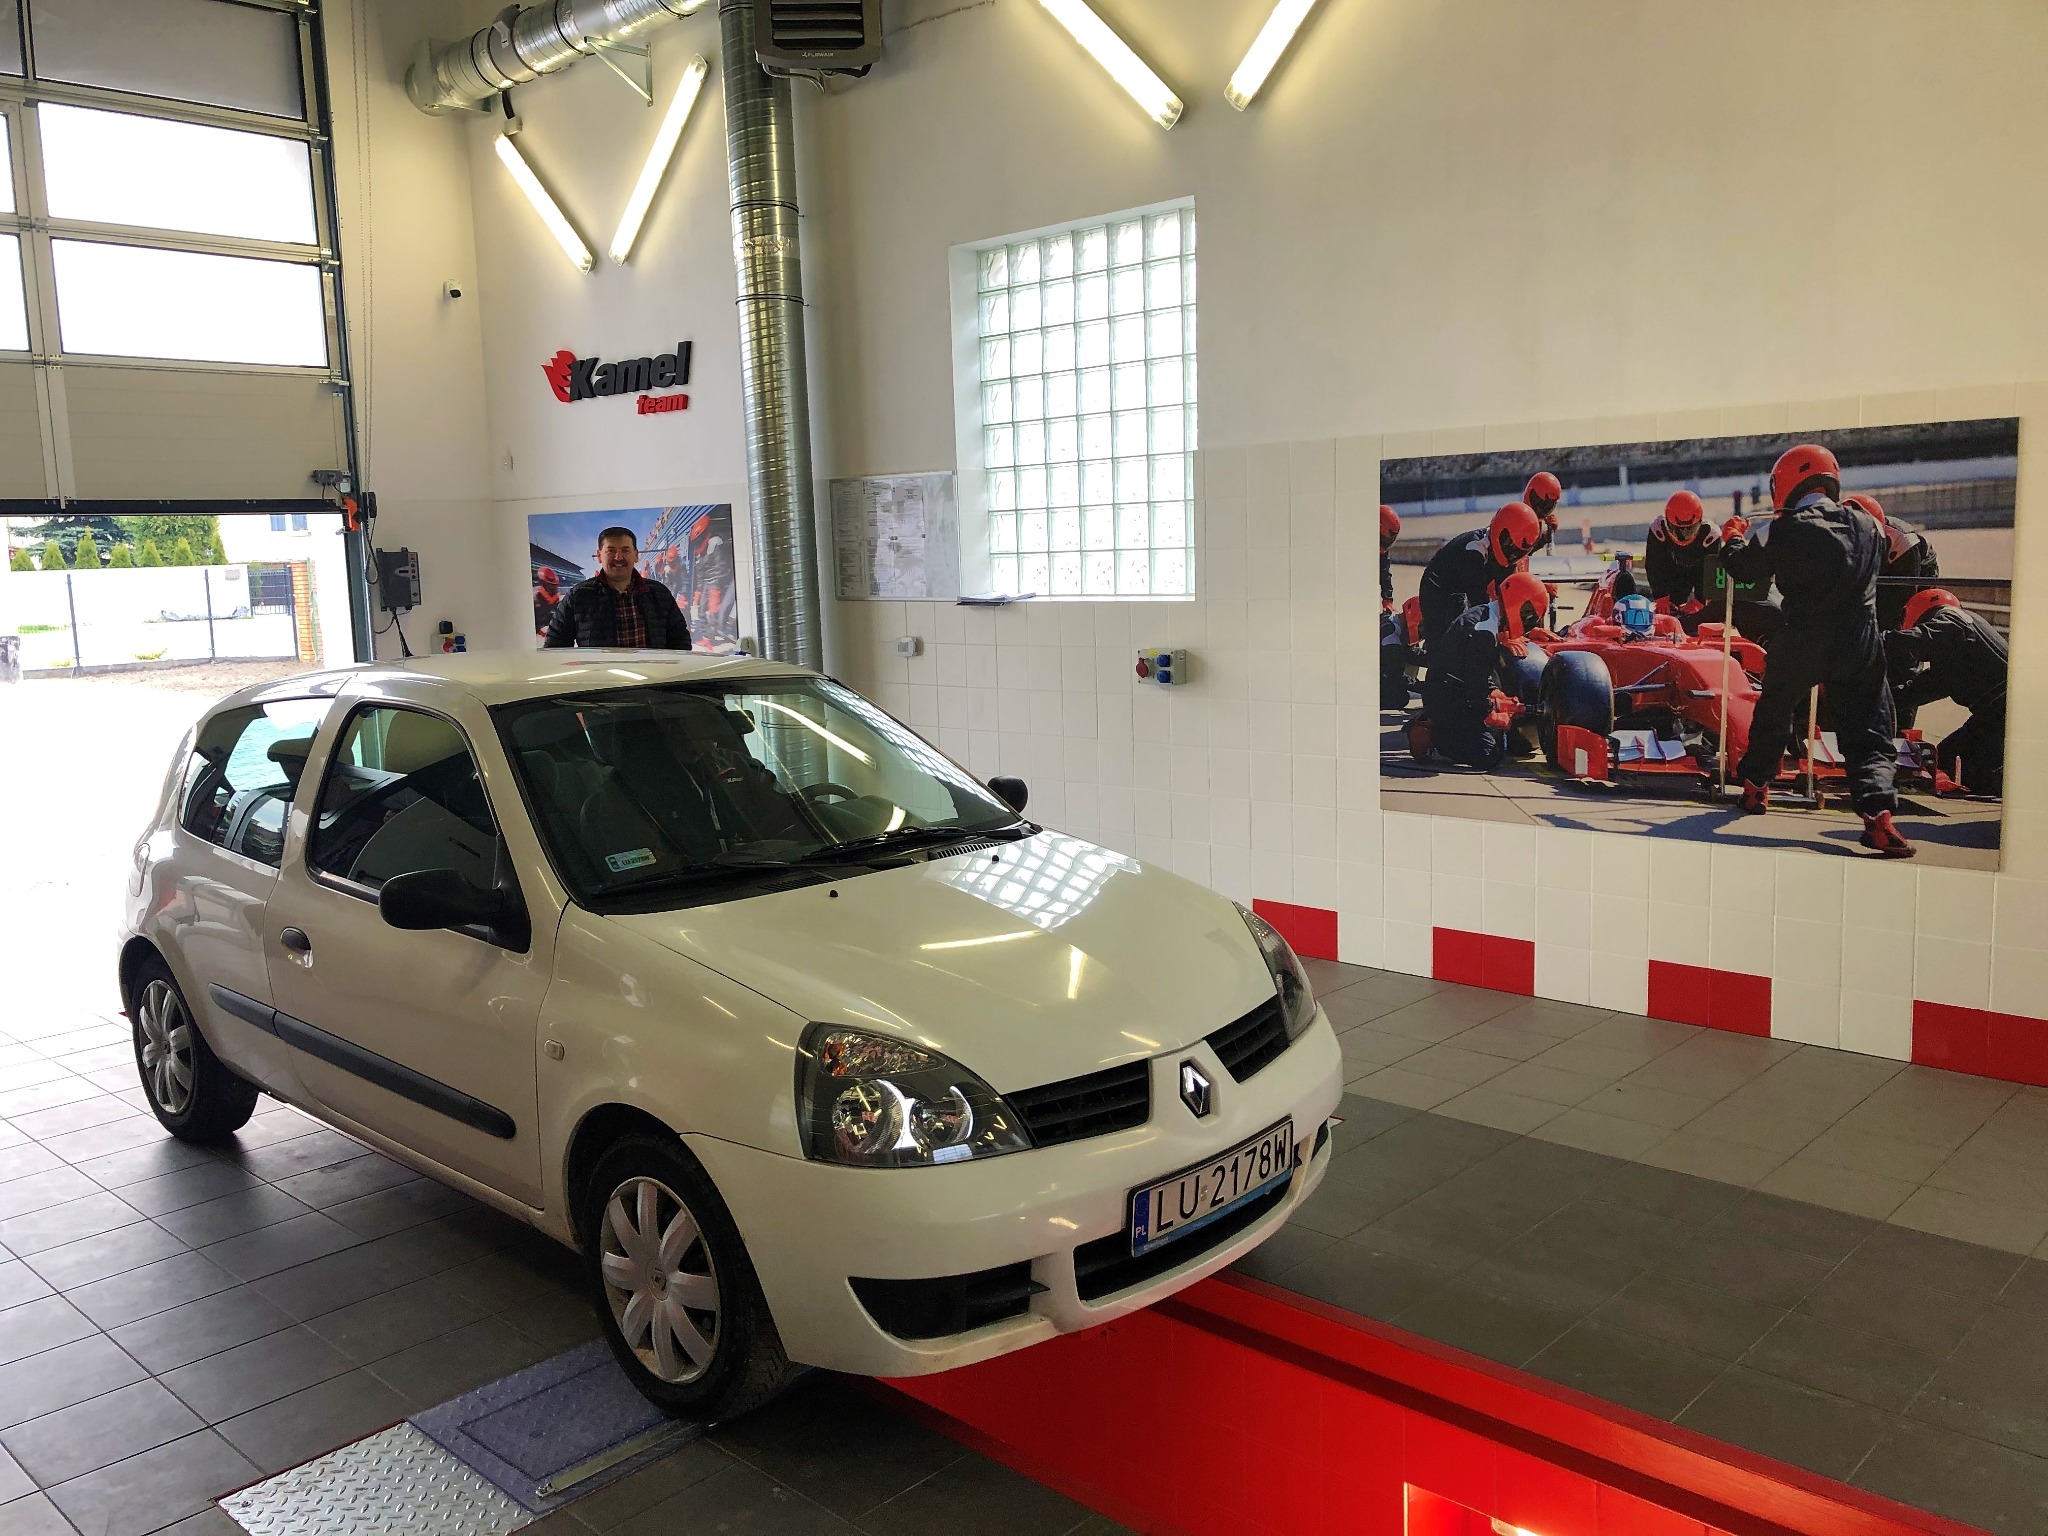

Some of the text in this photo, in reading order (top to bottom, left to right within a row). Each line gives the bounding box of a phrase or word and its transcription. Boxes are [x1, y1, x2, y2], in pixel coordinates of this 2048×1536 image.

[570, 341, 692, 400] Kamel
[637, 395, 689, 414] team
[1157, 1128, 1287, 1232] LU 2178W
[1135, 1224, 1147, 1239] PL
